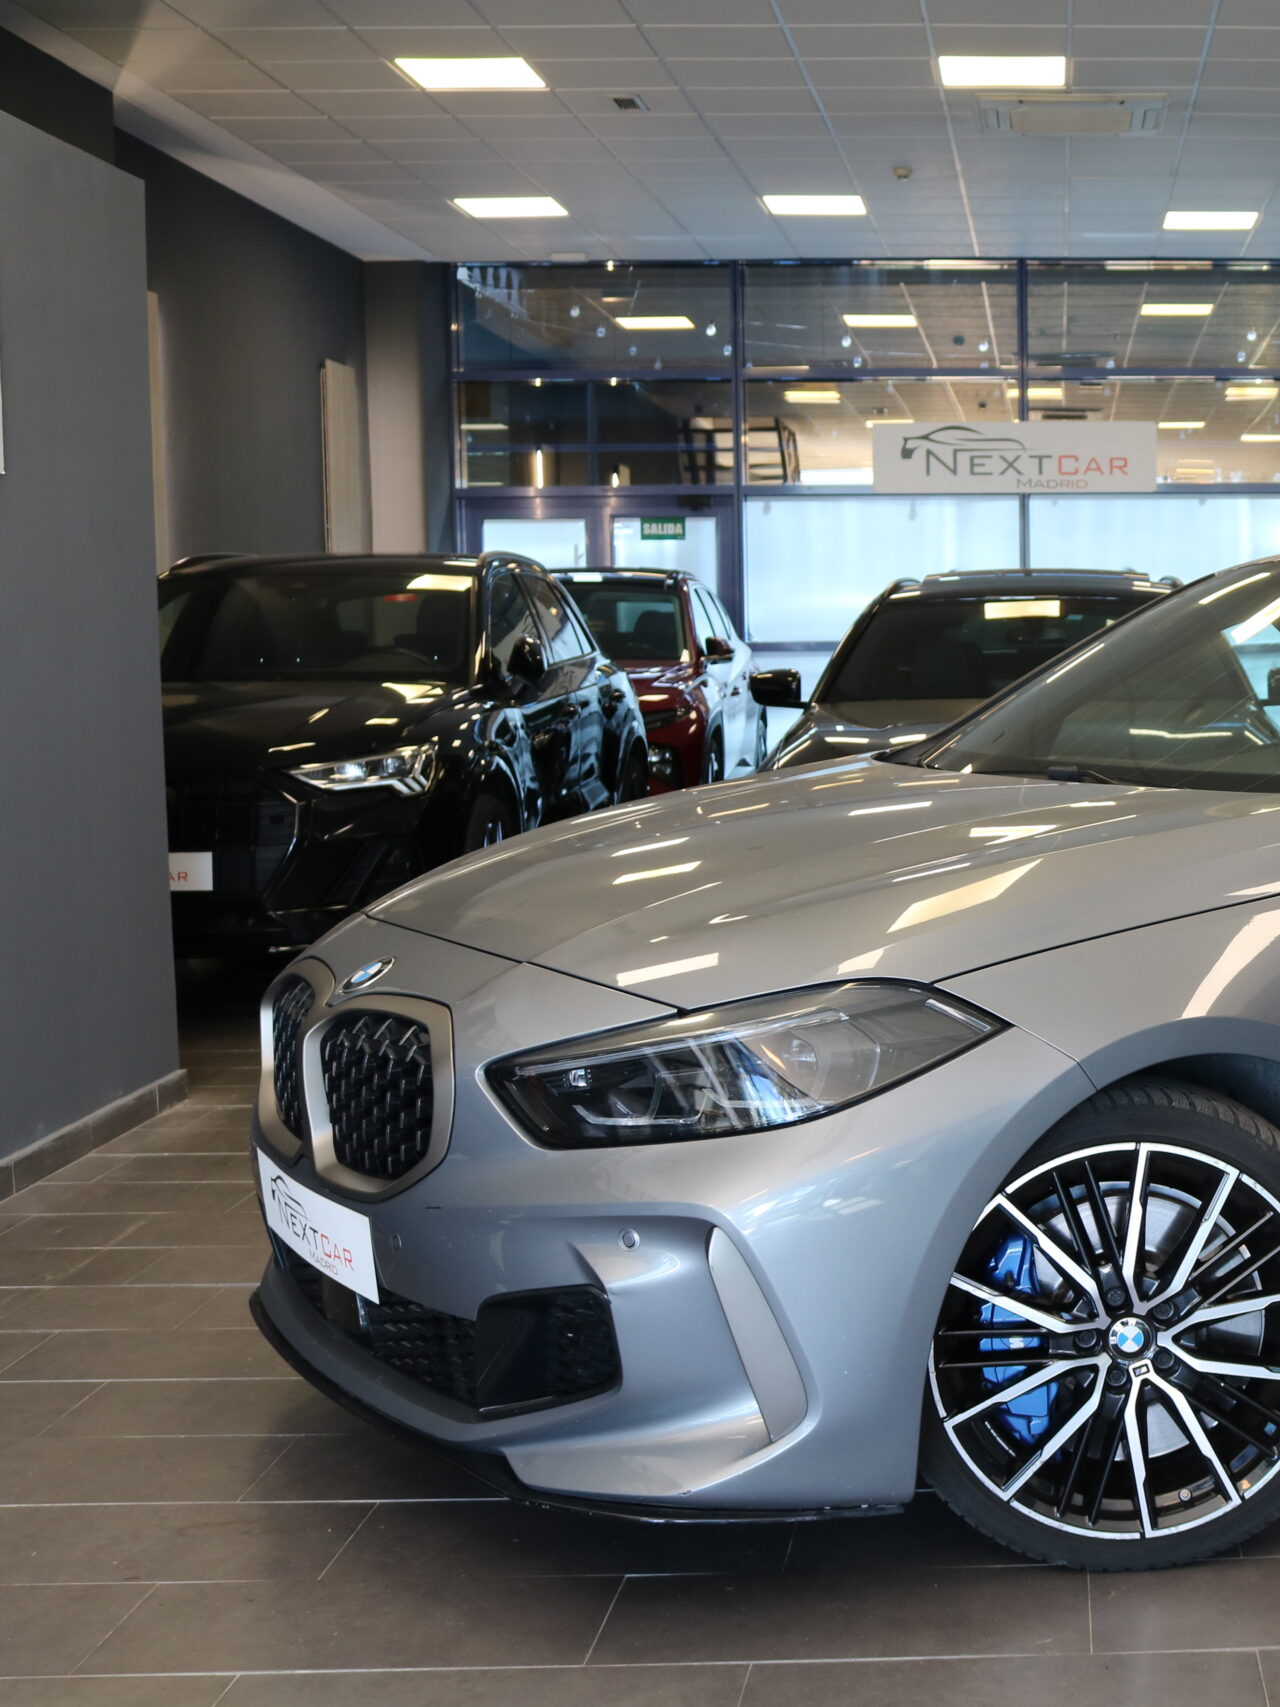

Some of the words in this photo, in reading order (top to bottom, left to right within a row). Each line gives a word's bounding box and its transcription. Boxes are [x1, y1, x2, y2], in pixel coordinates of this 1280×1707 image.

[926, 448, 1128, 477] NEXTCAR
[1016, 478, 1089, 490] MADRID
[643, 523, 683, 535] SALIDA
[278, 1195, 354, 1271] NEXTCAR
